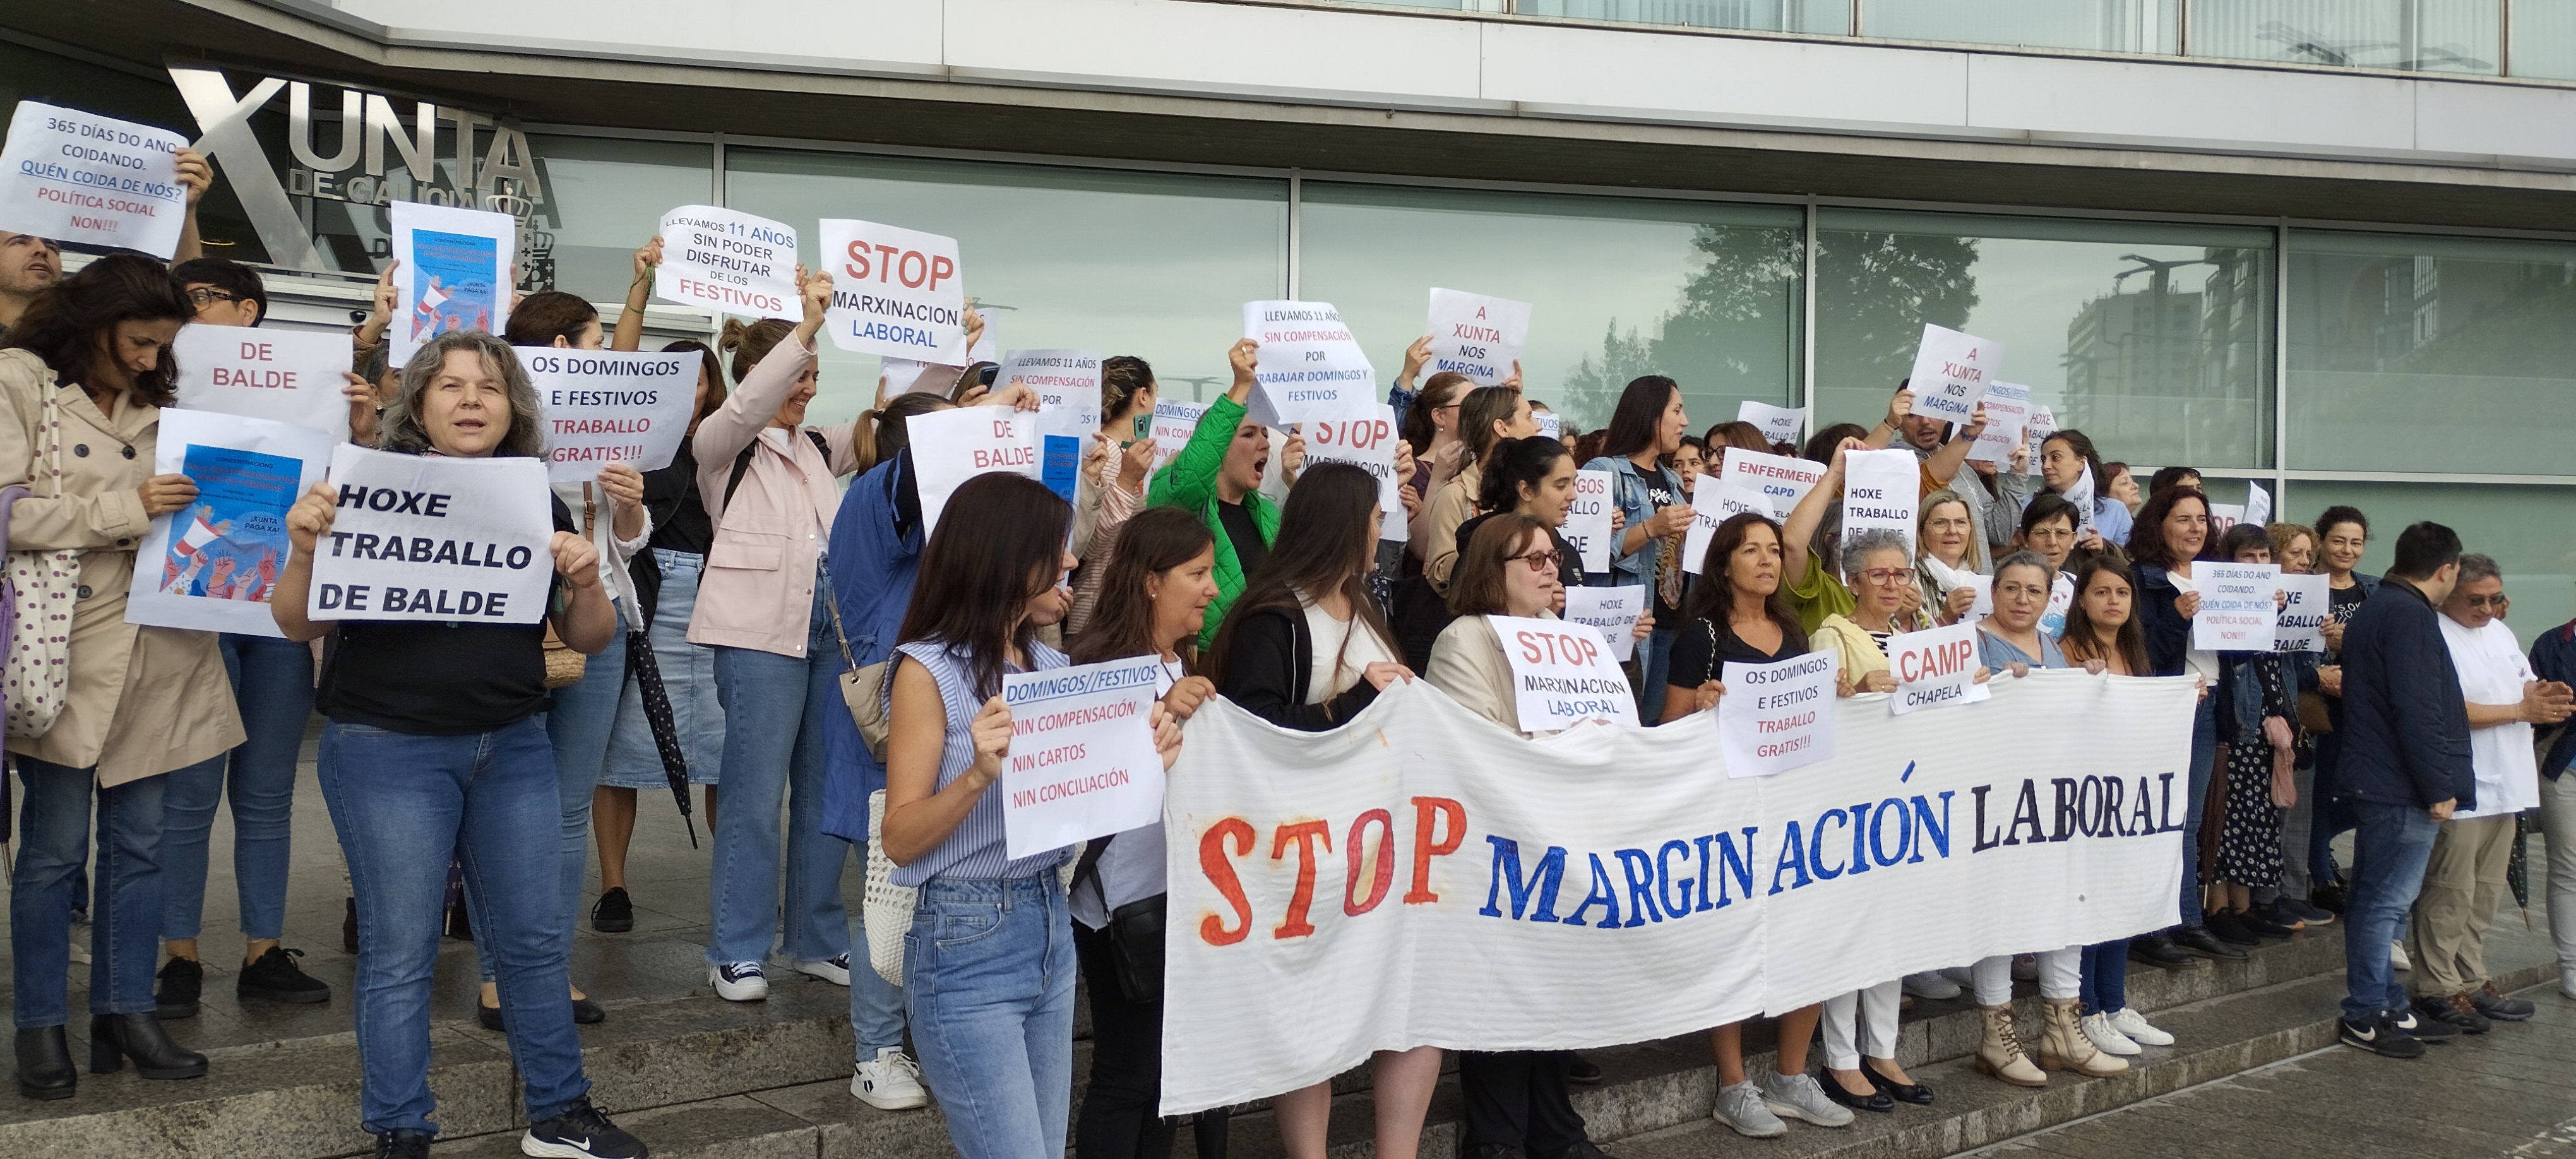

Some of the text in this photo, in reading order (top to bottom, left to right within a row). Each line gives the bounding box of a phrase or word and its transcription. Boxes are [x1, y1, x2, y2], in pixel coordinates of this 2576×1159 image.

[47, 118, 75, 133] 365
[81, 124, 114, 141] DÍAS
[118, 133, 140, 146] DO
[63, 145, 146, 170] COIDANDO.
[21, 160, 182, 199] QUÉN COIDA DE NÓS?
[167, 68, 542, 278] XUNTA
[289, 169, 334, 199] DE
[38, 187, 156, 217] POLÍTICA SOCIAL
[70, 216, 118, 232] NON!!!
[666, 218, 794, 249] LLEVAMOS 11 AÑOS
[693, 233, 773, 261] SIN PODER
[686, 249, 771, 277] DISFRUTAR
[845, 240, 953, 292] STOP
[710, 271, 748, 285] DE LOS
[680, 278, 782, 312] FESTIVOS
[833, 290, 958, 326] MARXINACION
[1265, 309, 1344, 323] LLEVAMOS 11 AÑO
[1476, 306, 1486, 320] A
[853, 319, 938, 348] LABORAL
[1264, 329, 1351, 343] SIN COMPENSACIÓN
[1453, 323, 1500, 343] XUNTA
[241, 342, 273, 361] DE
[1305, 351, 1326, 362] POR
[1458, 345, 1486, 359] NOS
[1967, 347, 1977, 361] A
[532, 356, 680, 376] OS DOMINGOS
[1018, 357, 1096, 369] LLEVAMOS 11 AÑOS
[1436, 359, 1494, 378] MARGINA
[1941, 361, 1982, 383] XUNTA
[213, 367, 297, 389] BALDE
[1010, 374, 1095, 388] SIN COMPENSACIÓN
[1307, 369, 1361, 382] DOMINGOS
[1361, 369, 1368, 379] Y
[552, 390, 658, 406] E FESTIVOS
[1288, 389, 1337, 401] FESTIVOS
[1944, 383, 1967, 397] NOS
[1042, 395, 1062, 405] POR
[1923, 396, 1969, 415] MARGINA
[552, 418, 650, 435] TRABALLO
[1770, 417, 1793, 427] HOXE
[2030, 413, 2051, 425] HOXE
[993, 420, 1014, 438] DE
[1155, 426, 1169, 436] NIN
[552, 444, 643, 463] GRATIS!!!
[974, 446, 1034, 468] BALDE
[1763, 485, 1795, 497] CAPD
[1851, 489, 1882, 499] HOXE
[337, 484, 451, 518] HOXE
[1722, 498, 1749, 513] HOXE
[1849, 507, 1908, 519] TRABALLO
[1848, 527, 1863, 537] DE
[331, 531, 532, 570] TRABALLO
[2212, 568, 2271, 580] 365 DÍAS DO ANO
[2217, 585, 2255, 594] COIDANDO.
[319, 584, 508, 617] DE BALDE
[1599, 599, 1623, 610] HOXE
[2200, 600, 2219, 609] QUÉN
[2222, 601, 2242, 609] COIDA
[2254, 600, 2272, 609] NÓS?
[1573, 615, 1637, 627] TRABALLO DE
[2206, 614, 2263, 626] POLÍTICA SOCIAL
[2221, 631, 2246, 639] NON!!!
[1516, 631, 1597, 667] STOP
[1746, 657, 1828, 684] OS DOMINGOS
[1900, 639, 1972, 683] CAMP
[1524, 675, 1626, 694] MARXINACION
[1758, 686, 1818, 710] E FESTIVOS
[1907, 684, 1962, 706] CHAPELA
[1547, 699, 1620, 716] LABORAL
[1011, 698, 1136, 737] NIN COMPENSACIÓN
[1757, 711, 1815, 734] TRABALLO
[1757, 735, 1811, 758] GRATIS!!!
[1012, 742, 1085, 773] NIN CARTOS
[1013, 767, 1130, 809] NIN CONCILIACIÓN
[1198, 795, 1467, 947] STOP
[1971, 772, 2186, 853] LABORAL
